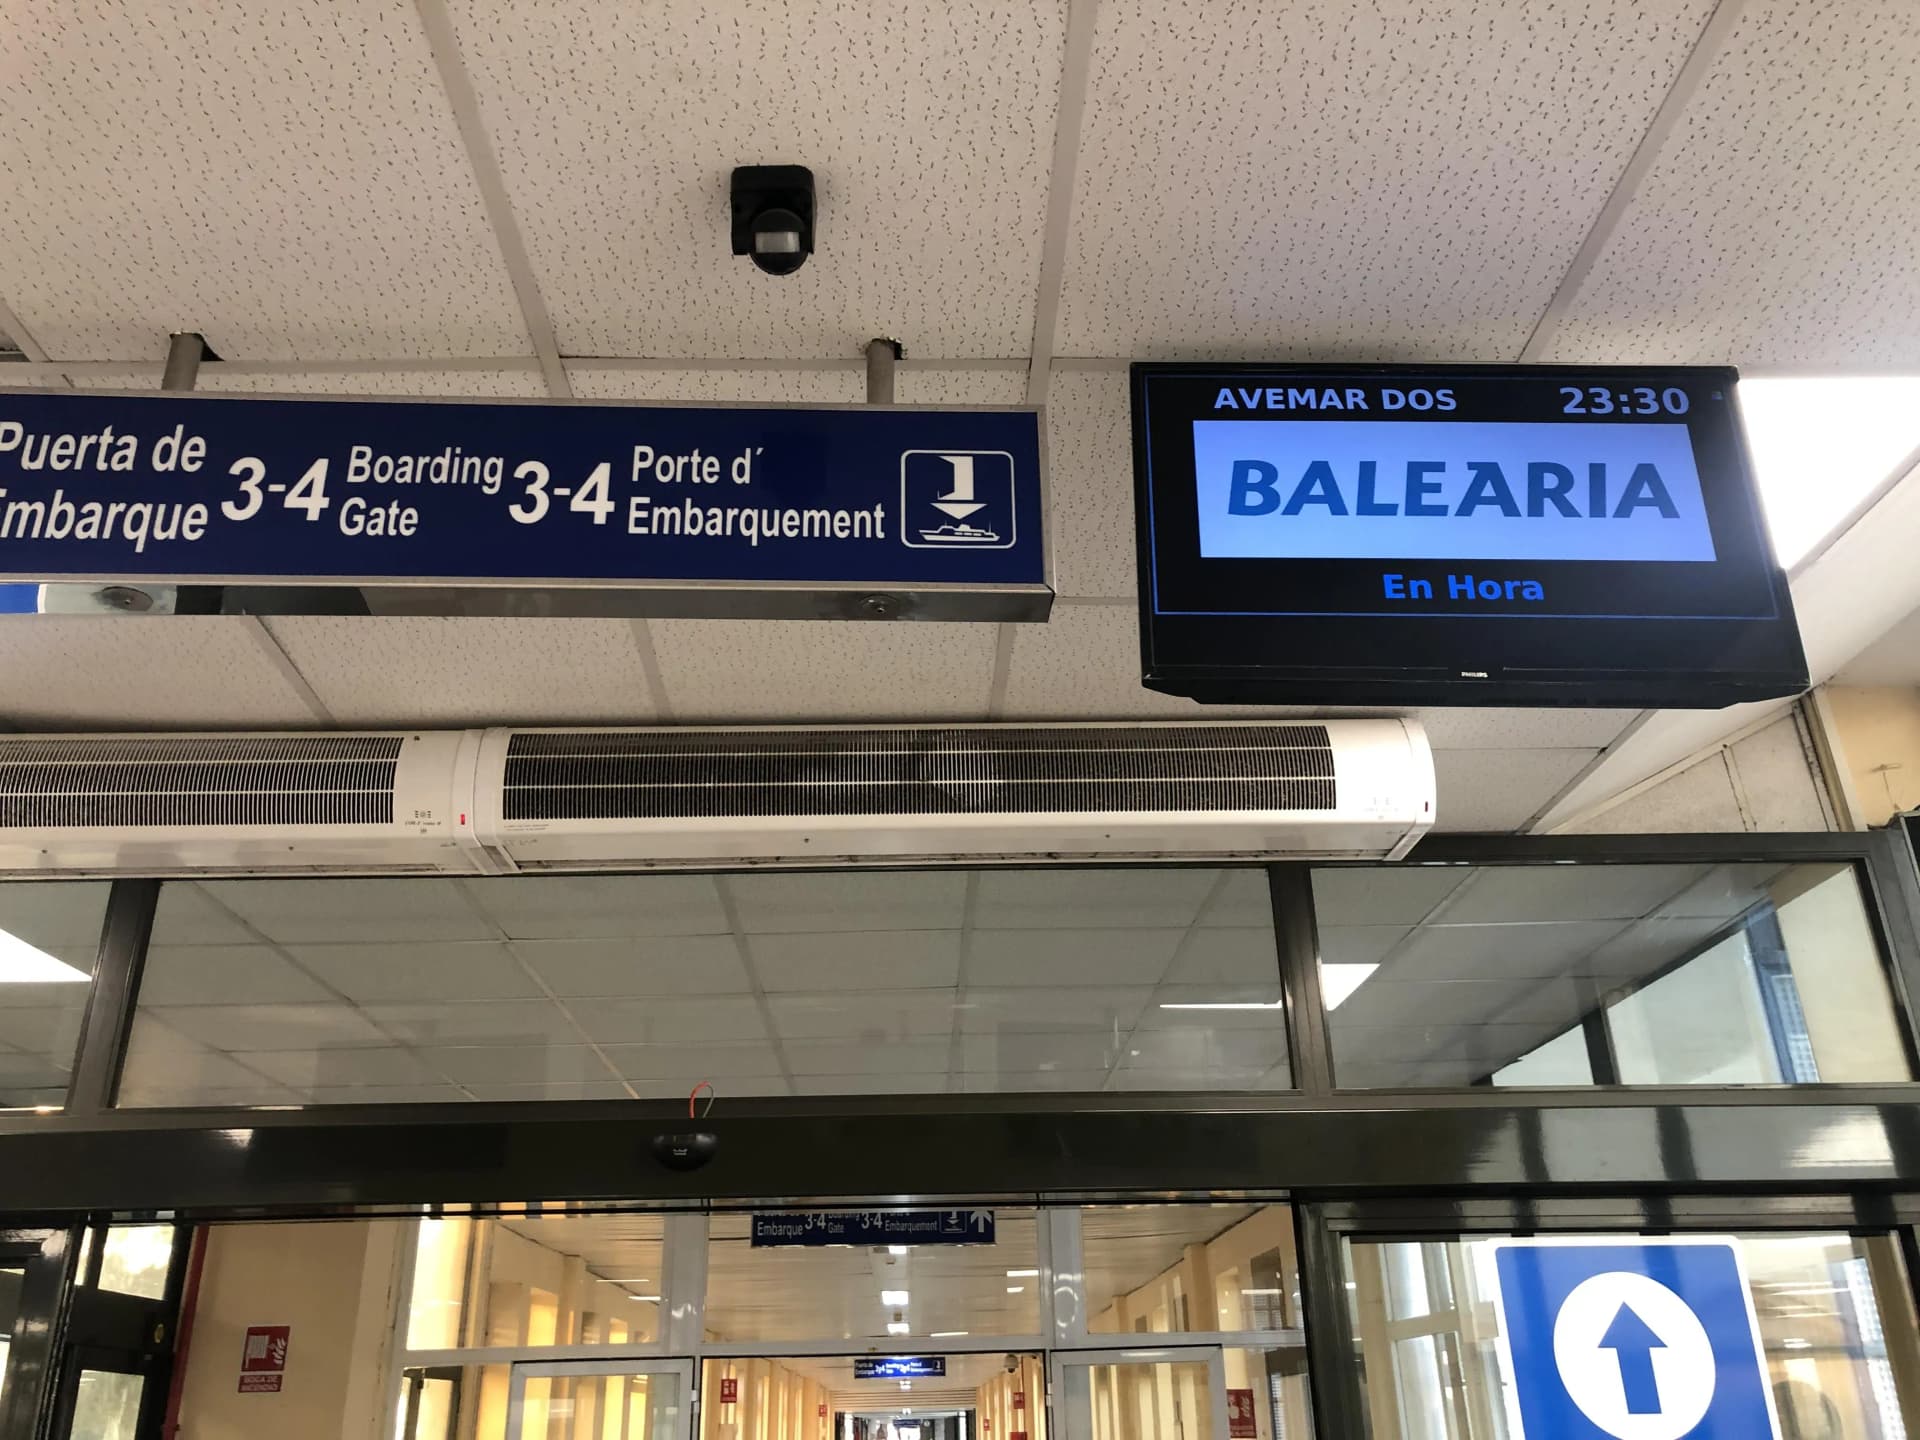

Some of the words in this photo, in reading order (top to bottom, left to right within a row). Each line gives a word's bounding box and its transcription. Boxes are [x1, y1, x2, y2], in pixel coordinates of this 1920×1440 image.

[1214, 388, 1369, 411] AVEMAR
[1382, 388, 1457, 412] DOS
[1559, 387, 1690, 415] 23:30
[0, 421, 138, 472] Puerta
[152, 424, 207, 473] de
[632, 445, 720, 484] Porte
[221, 457, 330, 522] 3-4
[346, 445, 504, 495] Boarding
[1227, 459, 1681, 520] BALEARIA
[508, 460, 616, 525] 3-4
[339, 496, 419, 537] Gate
[628, 496, 886, 547] Embarquement
[1383, 573, 1433, 599] En
[1447, 573, 1545, 602] Hora
[757, 1221, 803, 1239] Embarque
[827, 1222, 845, 1234] Gate
[884, 1219, 937, 1234] Embarquement
